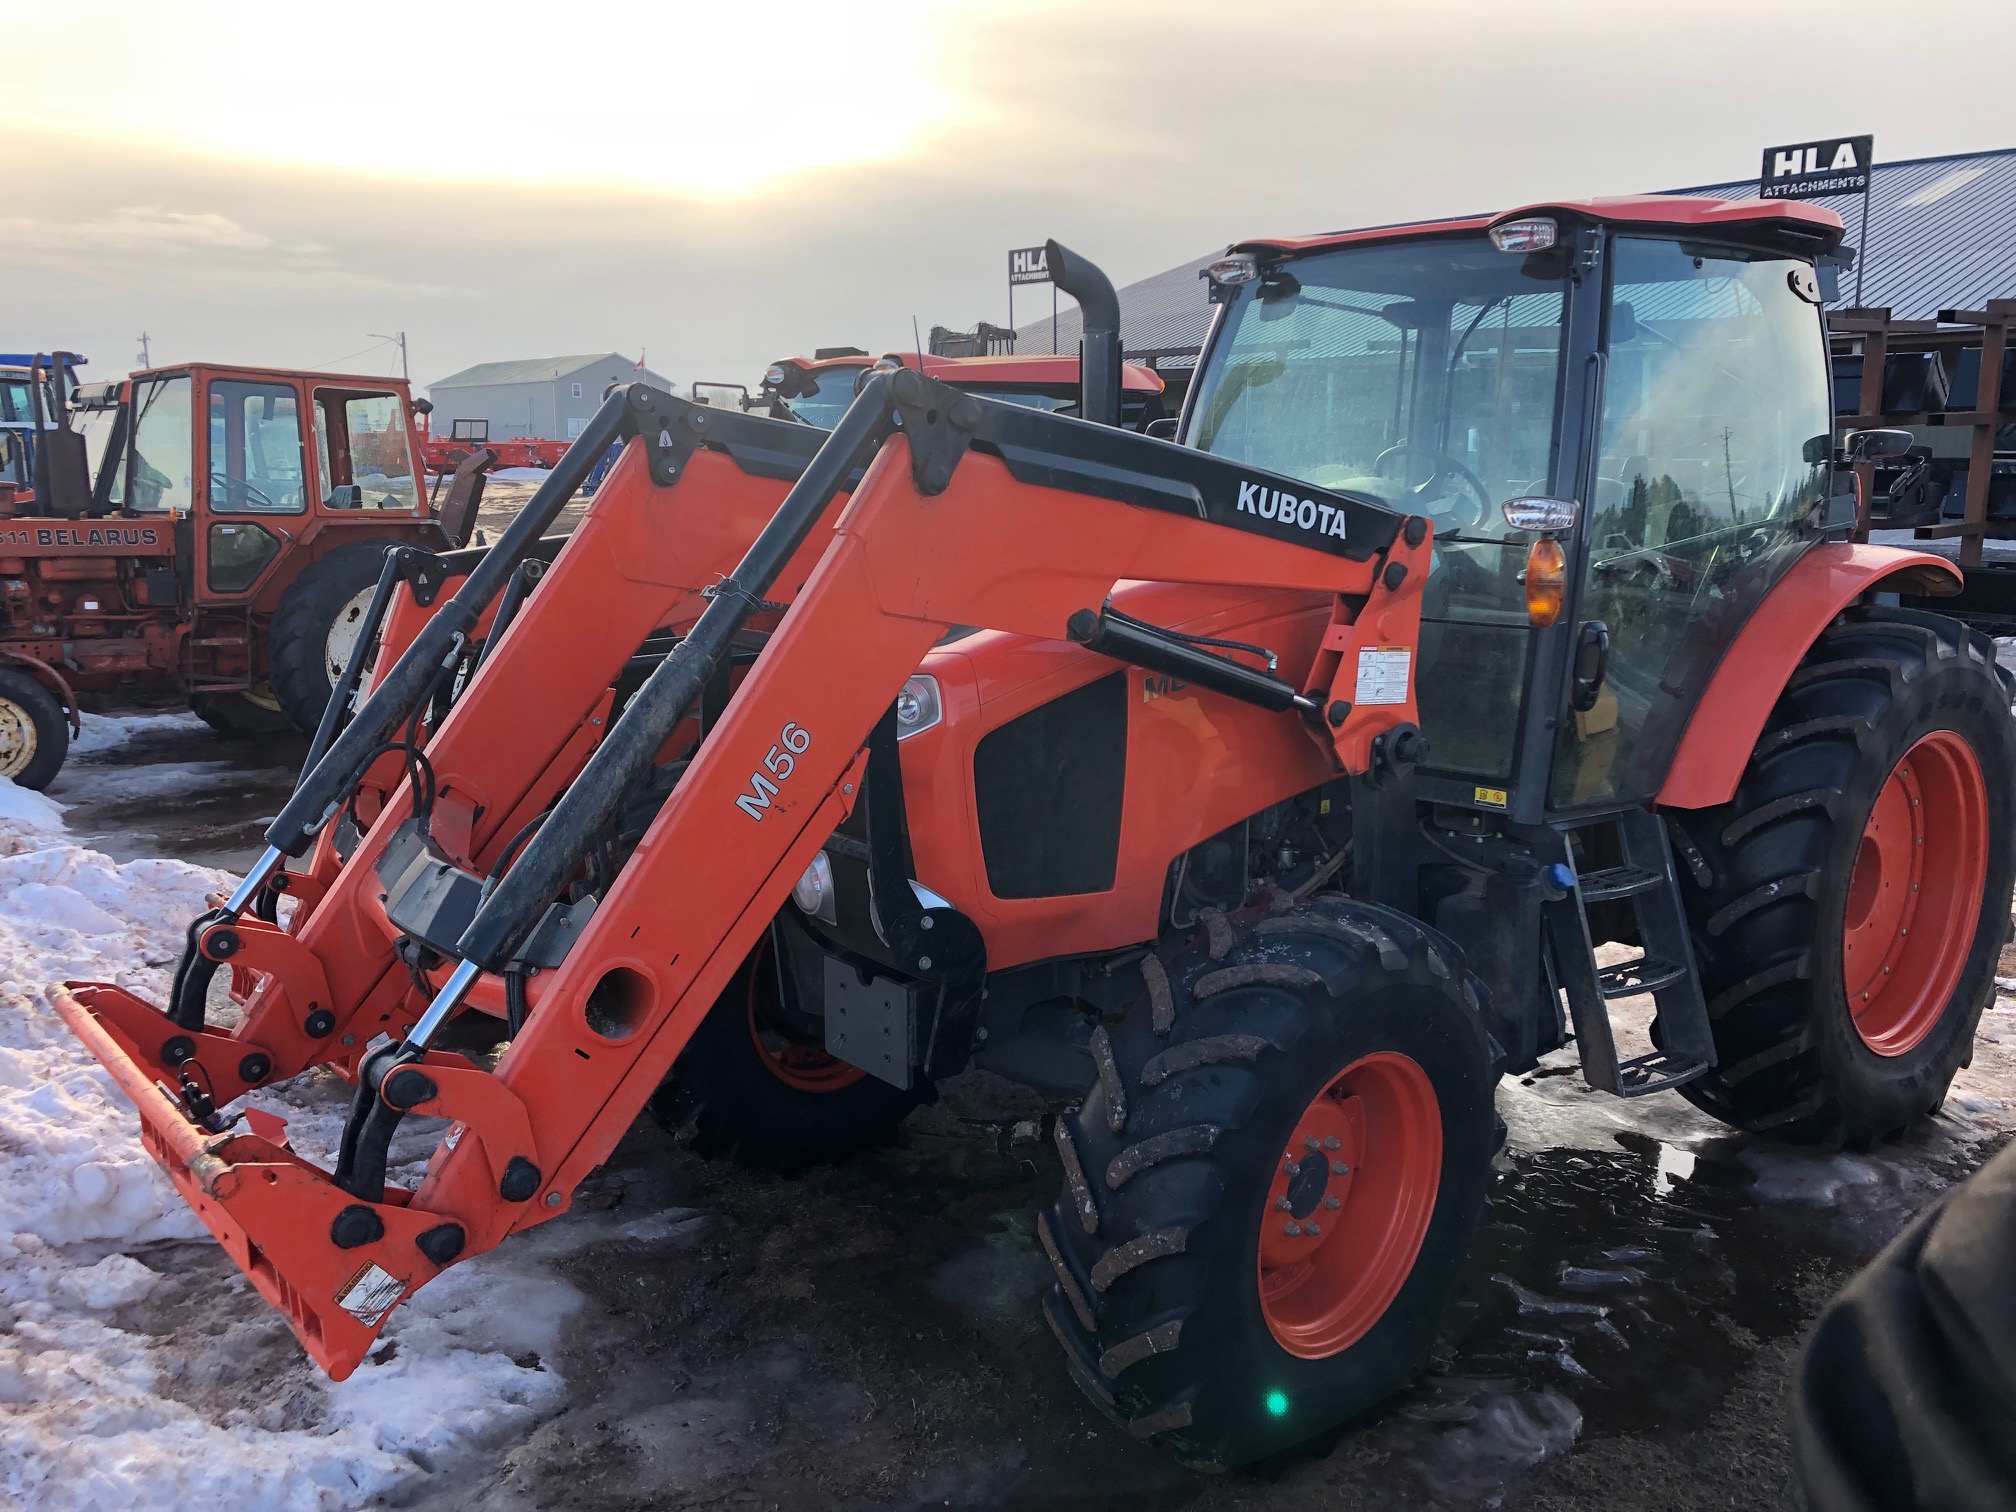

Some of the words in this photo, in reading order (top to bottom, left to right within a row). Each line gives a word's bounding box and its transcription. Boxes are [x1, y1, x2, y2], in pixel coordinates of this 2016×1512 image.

[1774, 142, 1858, 177] HLA
[1763, 175, 1866, 197] ATTACHMENTS
[1013, 249, 1049, 273] HLA
[1237, 480, 1346, 540] KUBOTA
[36, 528, 158, 547] BELARUS
[735, 721, 811, 822] M56
[341, 1261, 375, 1298] WARNING
